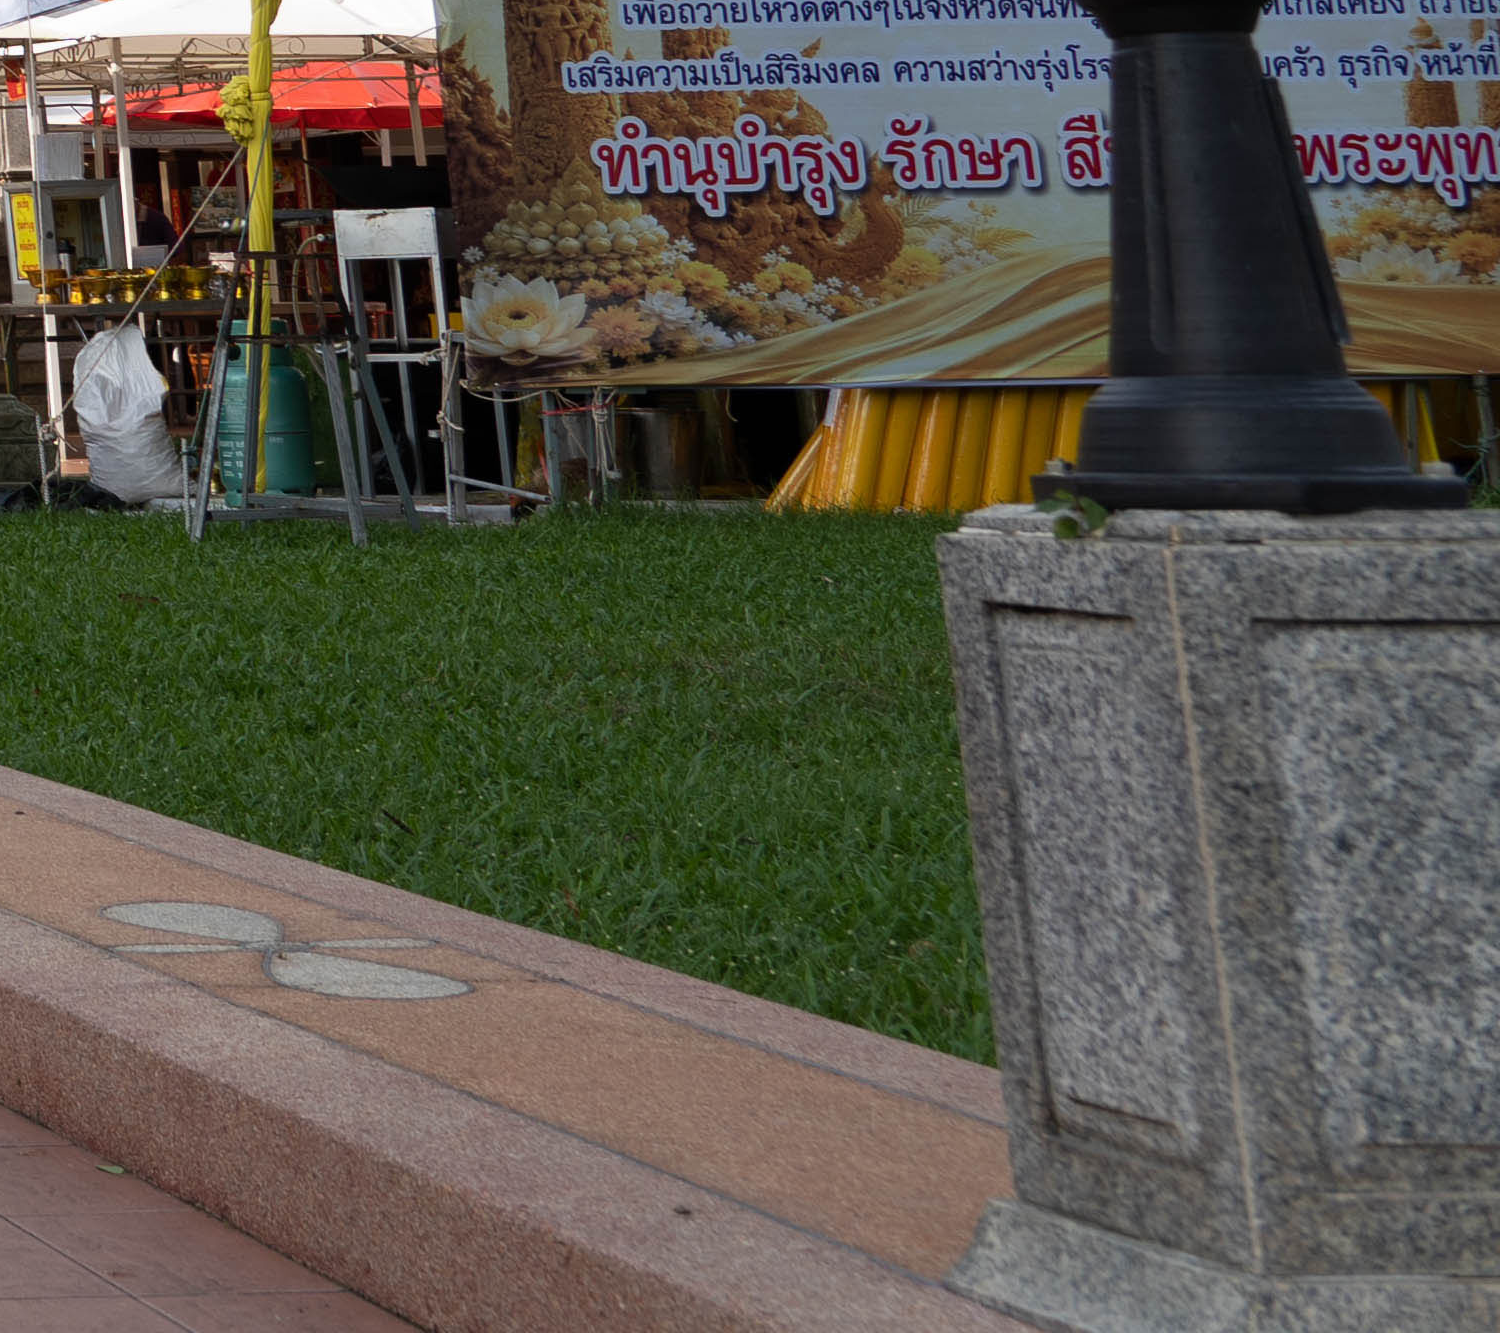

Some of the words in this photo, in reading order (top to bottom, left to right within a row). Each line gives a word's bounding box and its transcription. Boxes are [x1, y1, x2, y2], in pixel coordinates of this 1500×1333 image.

[565, 53, 881, 88] เสริมความเป็นสิริมงคล
[1339, 45, 1410, 88] ธุรกิจ
[598, 121, 862, 210] ทำนุบำรุง
[885, 118, 1040, 182] รักษา
[1293, 131, 1500, 200] พระพุท
